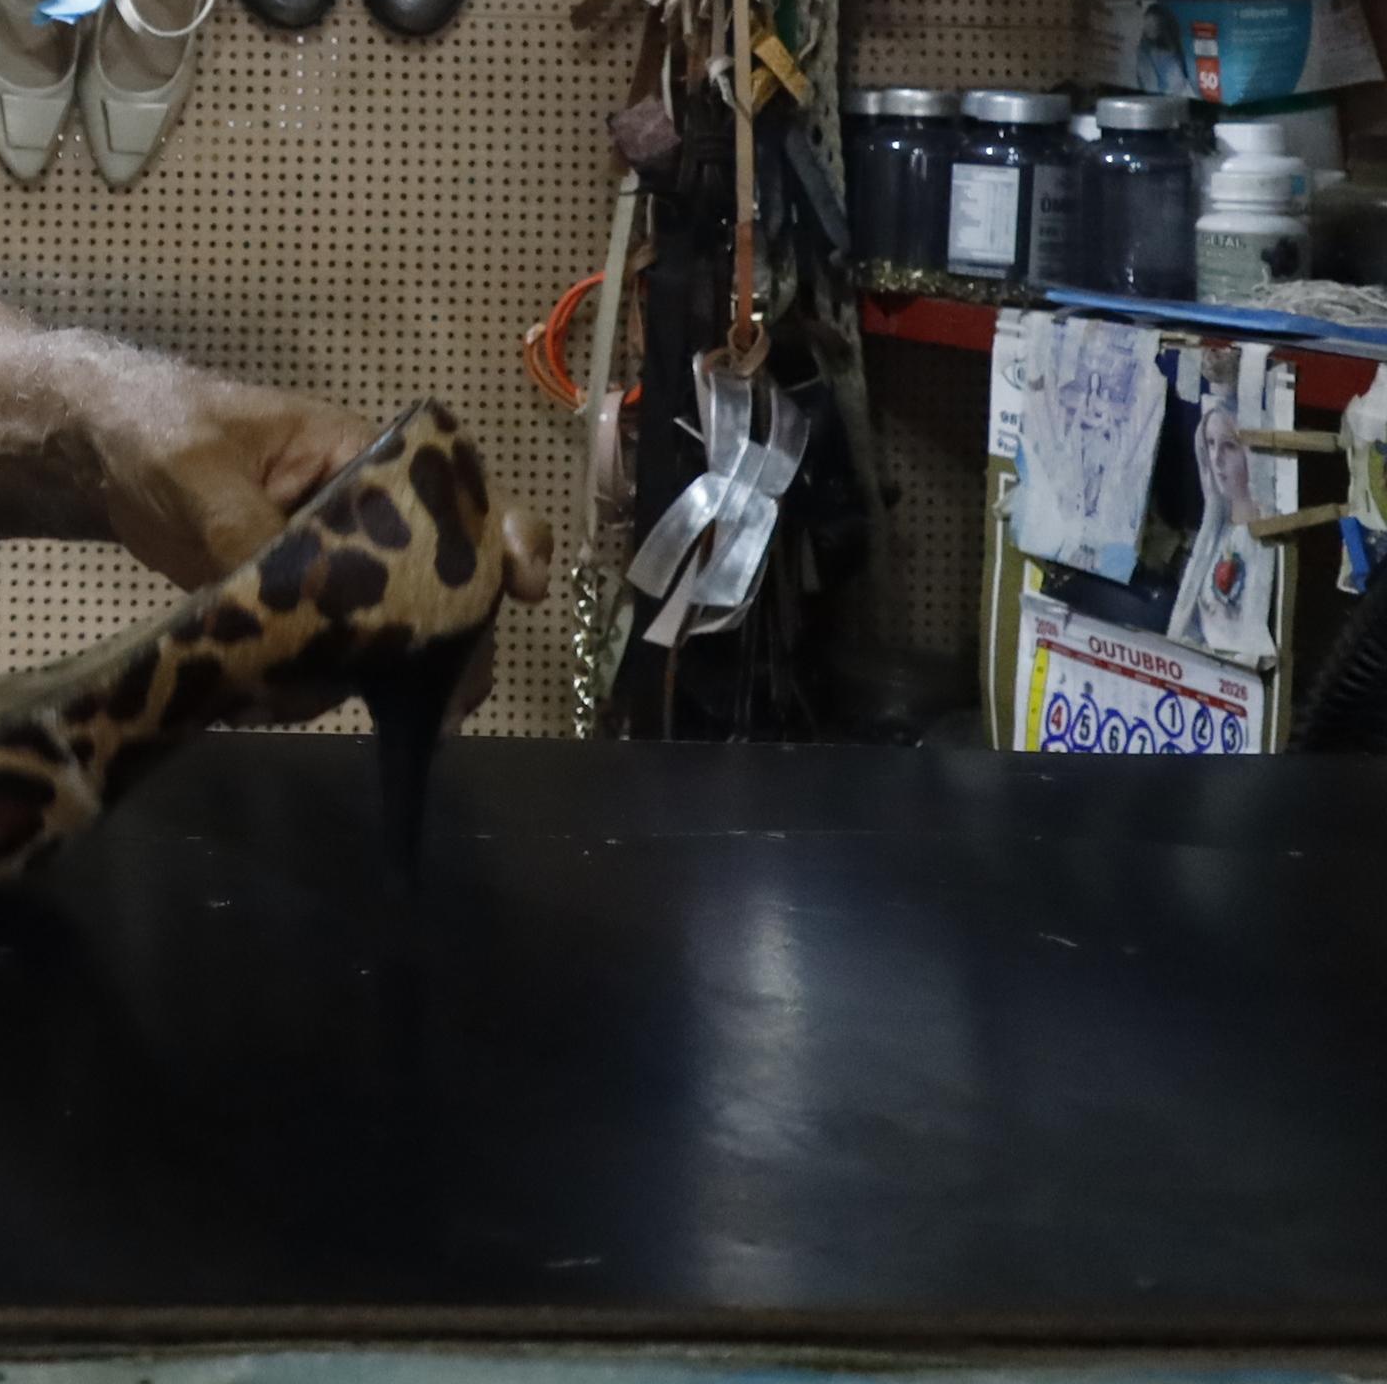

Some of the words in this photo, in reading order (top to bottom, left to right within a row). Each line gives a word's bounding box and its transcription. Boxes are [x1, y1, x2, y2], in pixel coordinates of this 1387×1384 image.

[1198, 71, 1219, 91] 50
[1088, 635, 1183, 681] OUTUBRO
[1051, 704, 1063, 731] 4
[1079, 712, 1091, 742] 5
[1109, 724, 1120, 752] 6
[1168, 702, 1177, 730] 1
[1198, 713, 1209, 741] 2
[1227, 722, 1238, 750] 3
